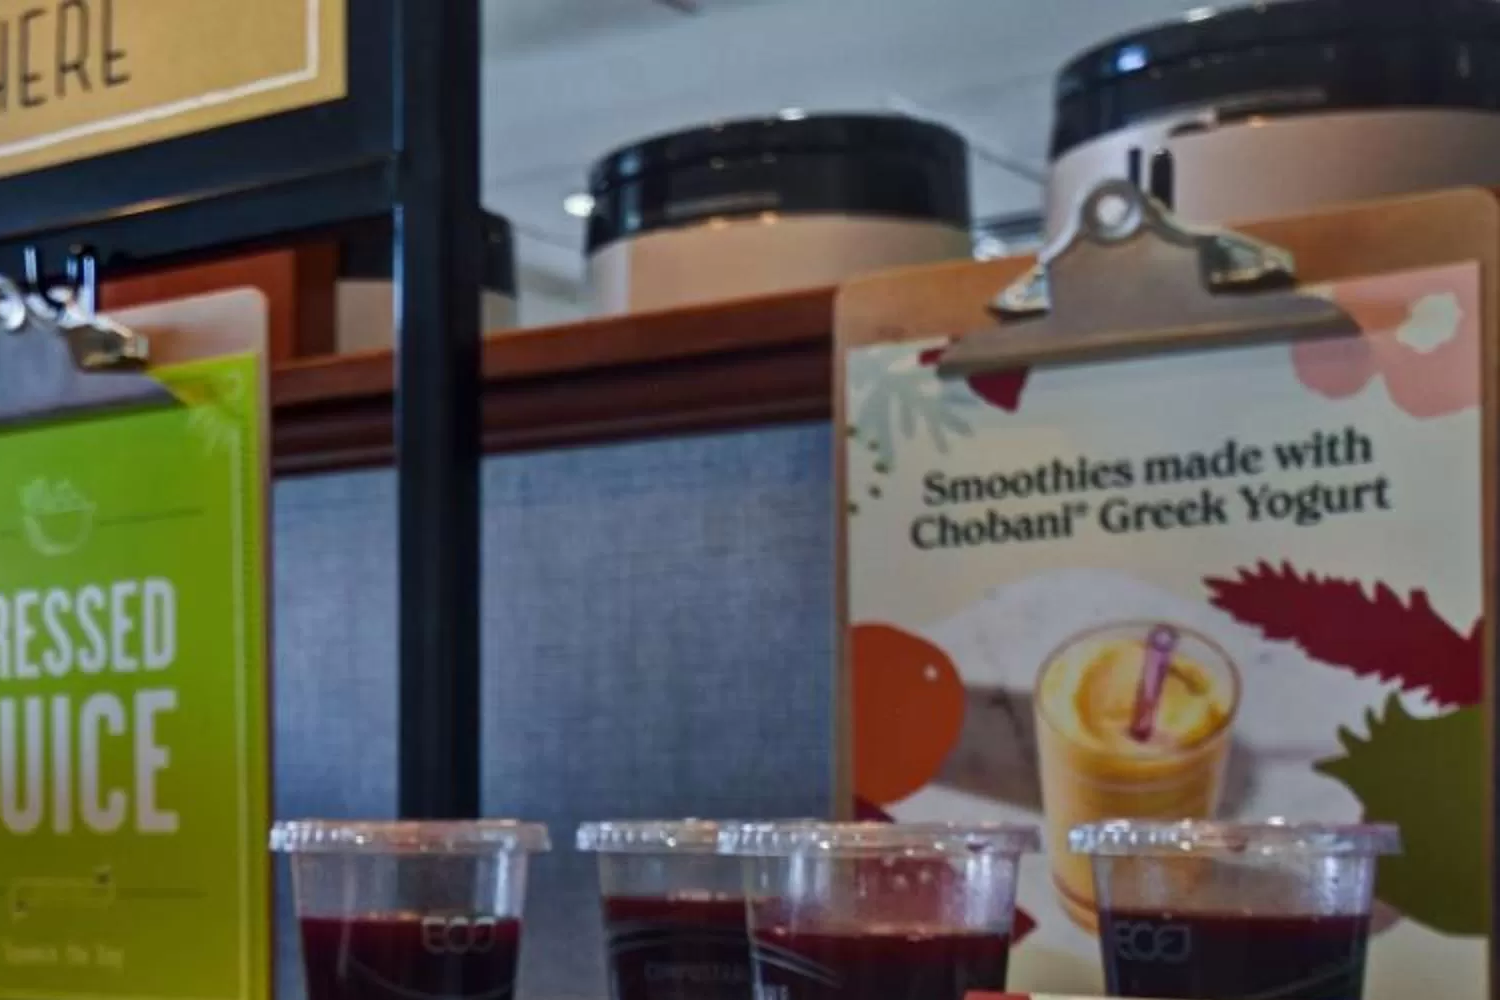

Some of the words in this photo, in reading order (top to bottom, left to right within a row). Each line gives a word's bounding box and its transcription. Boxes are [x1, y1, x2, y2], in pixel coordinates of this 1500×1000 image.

[922, 454, 1134, 506] Smoothies
[1143, 440, 1263, 486] made
[1272, 424, 1372, 469] with
[1097, 491, 1228, 534] Greek
[1236, 474, 1390, 526] Yogurt
